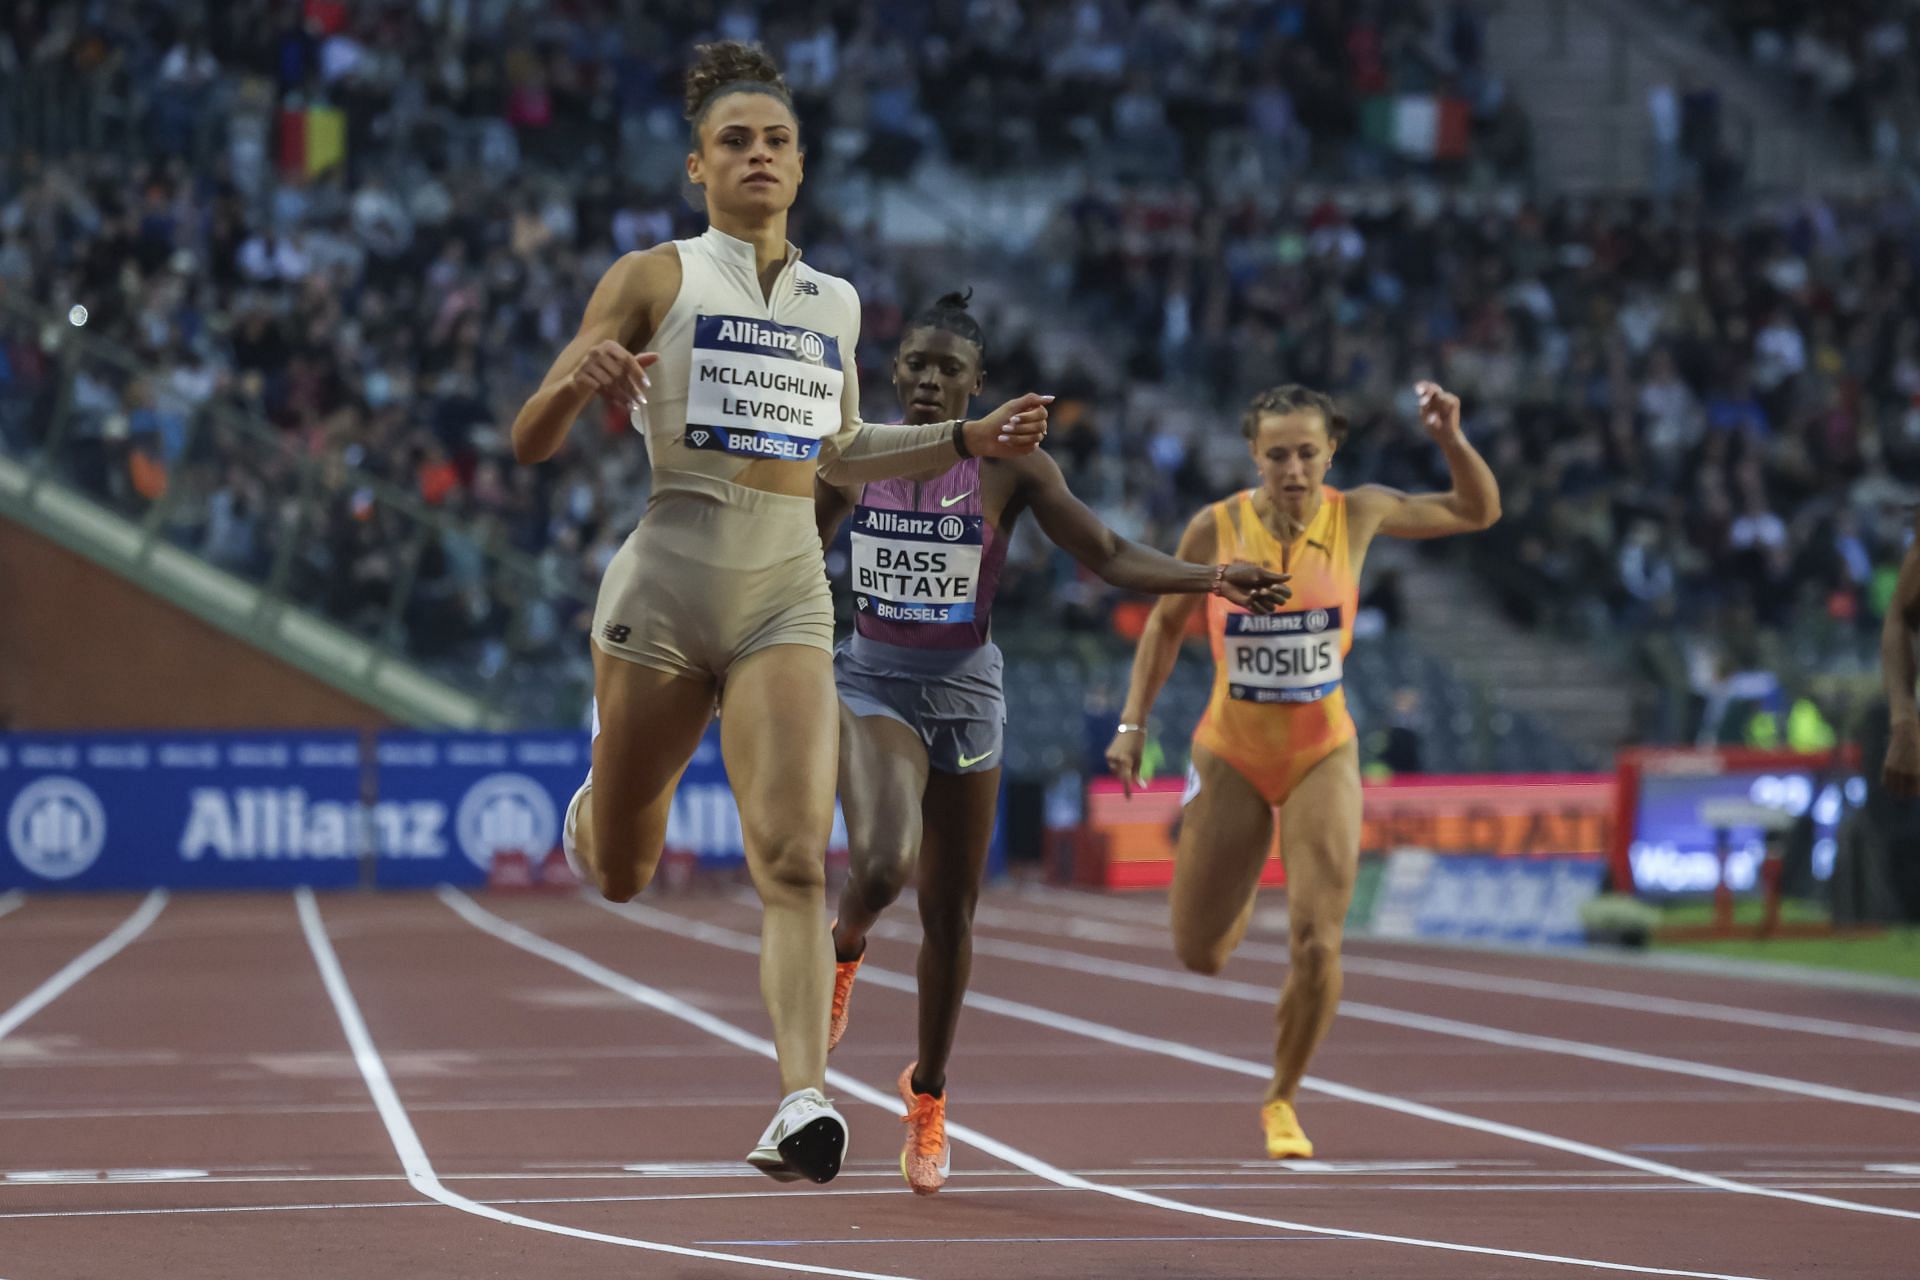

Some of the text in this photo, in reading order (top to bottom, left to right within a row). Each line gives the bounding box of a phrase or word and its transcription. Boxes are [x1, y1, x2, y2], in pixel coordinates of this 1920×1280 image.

[717, 319, 797, 350] Allianz
[700, 365, 833, 400] MCLAUGHLIN-
[722, 398, 814, 427] LEVRONE
[728, 433, 811, 458] BRUSSELS
[866, 510, 934, 535] Allianz
[876, 547, 947, 573] BASS
[859, 567, 970, 598] BITTAYE
[877, 603, 949, 621] BRUSSELS
[1239, 614, 1303, 632] Allianz
[1236, 641, 1332, 676] ROSIUS
[180, 785, 448, 860] Allianz
